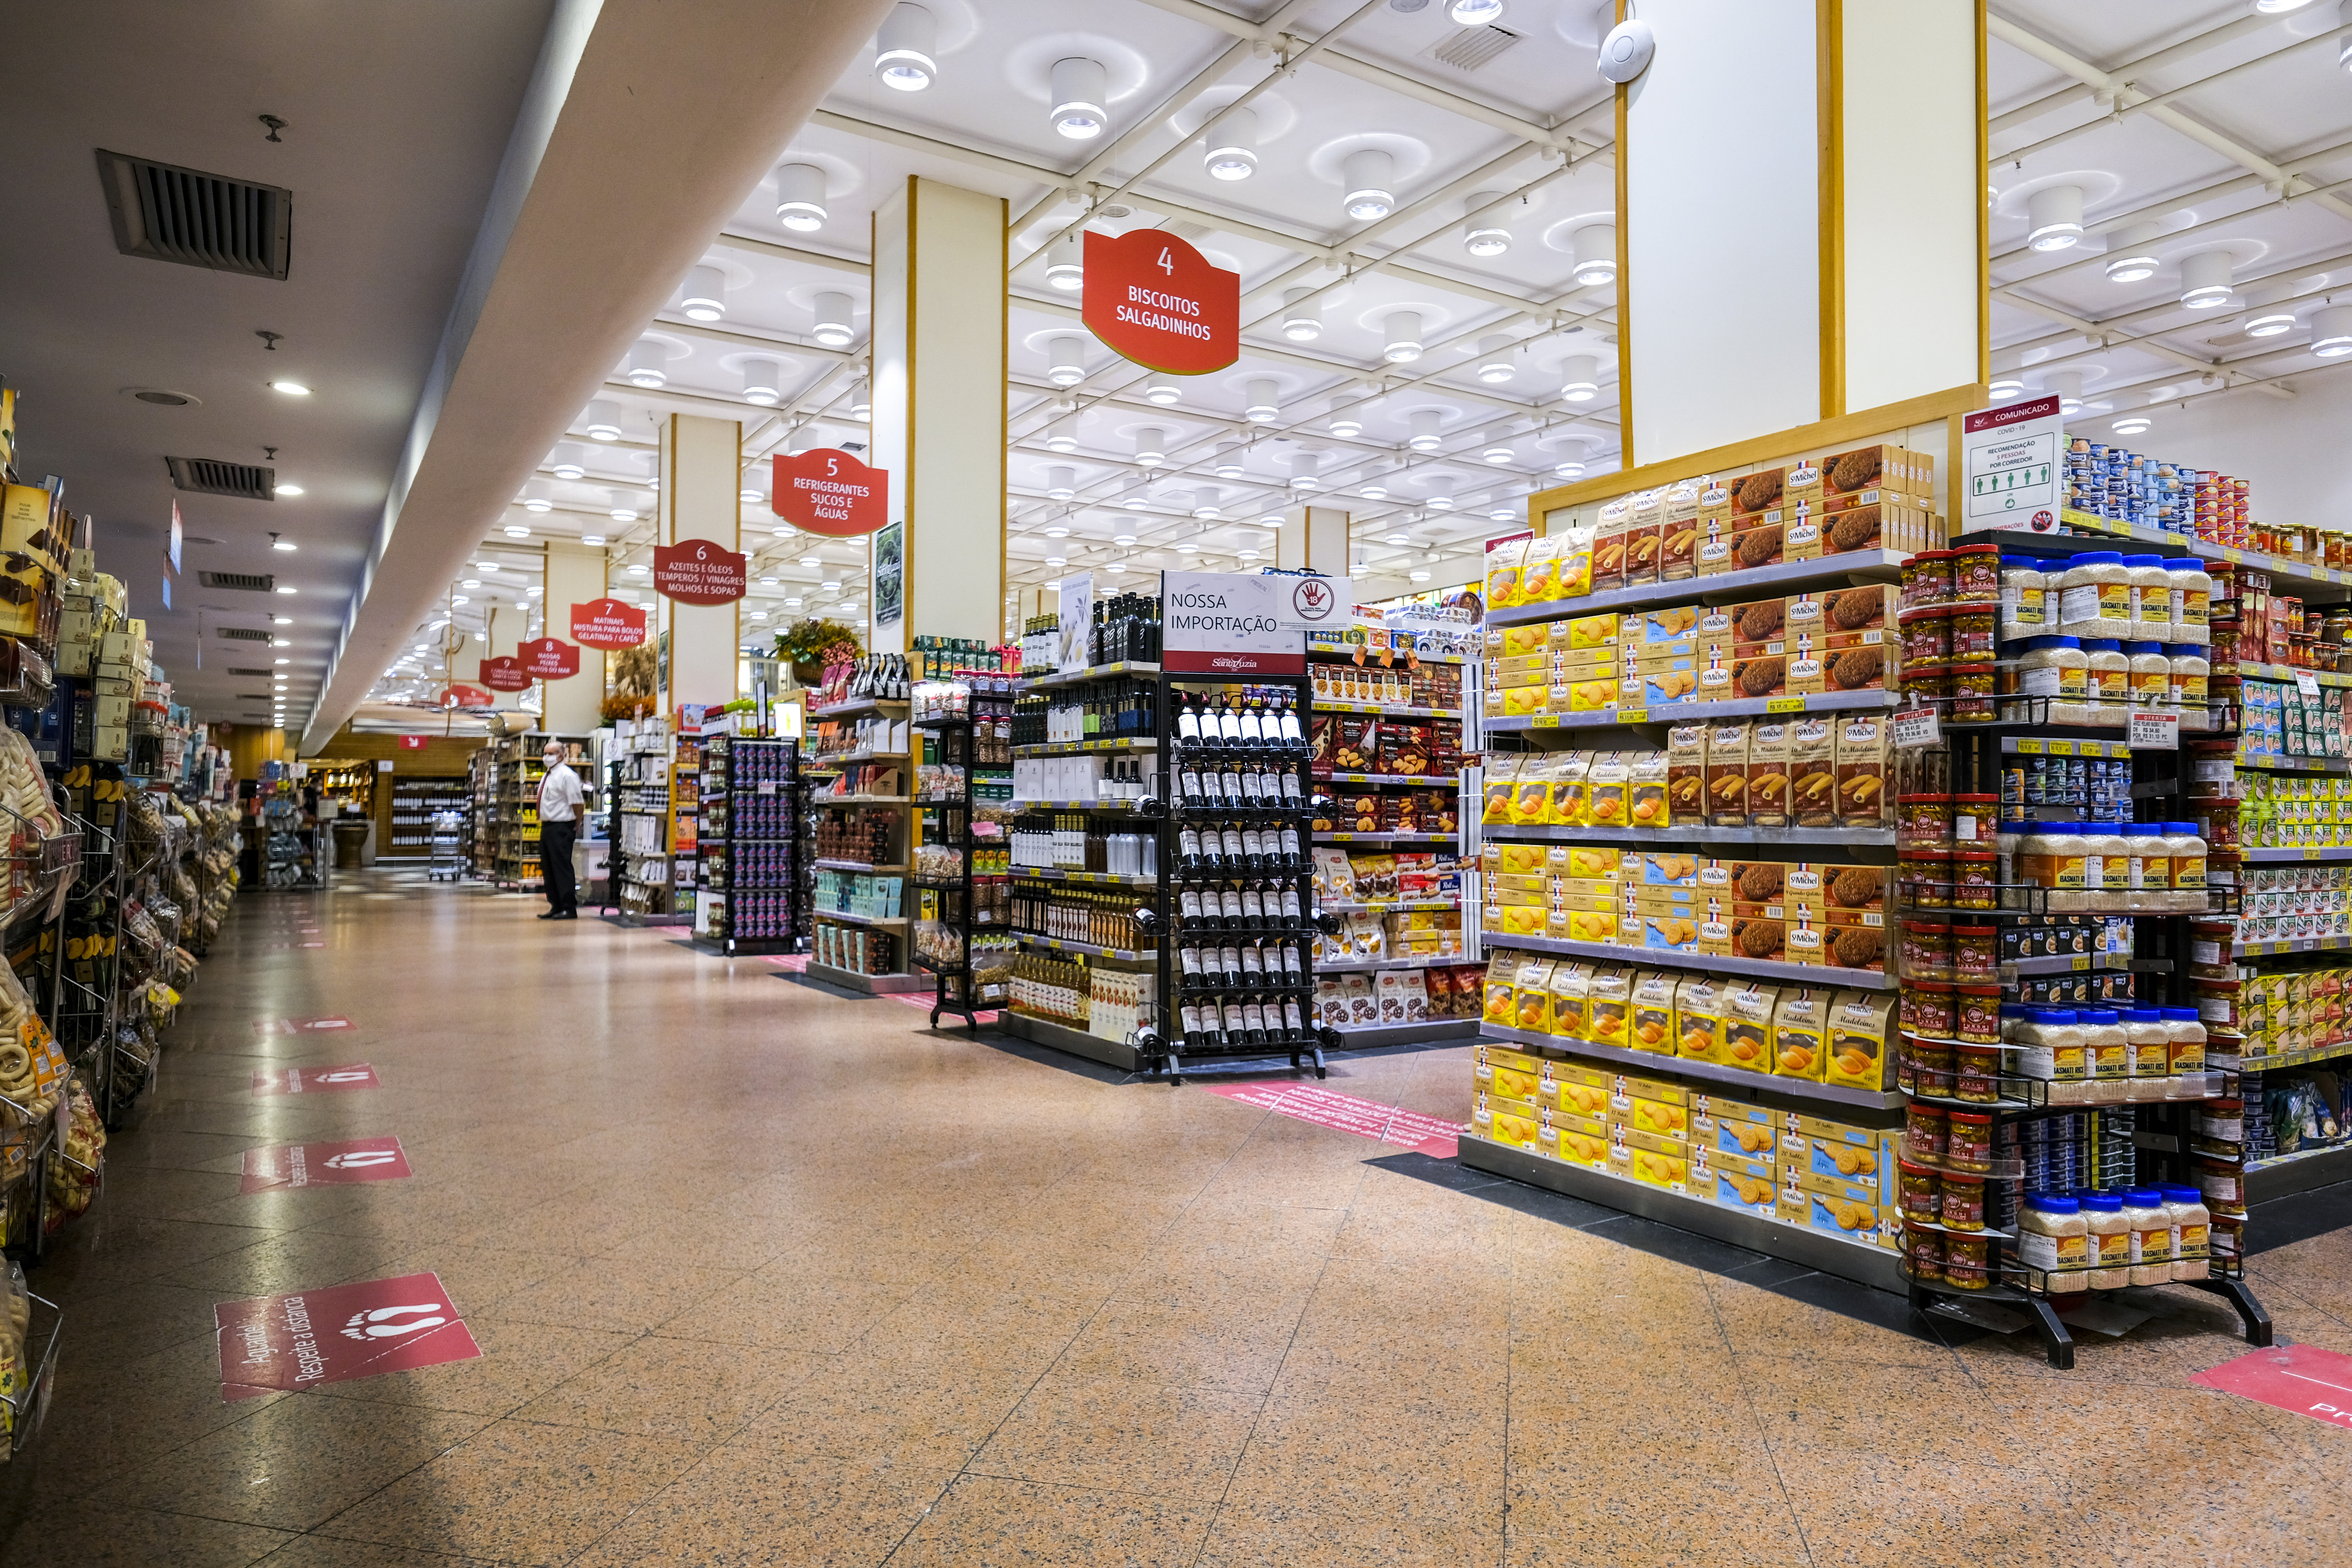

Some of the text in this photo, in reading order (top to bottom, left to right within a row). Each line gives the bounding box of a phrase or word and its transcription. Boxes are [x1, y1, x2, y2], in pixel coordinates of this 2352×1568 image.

[1157, 247, 1173, 276] 4
[1129, 285, 1200, 317] BISCOITOS
[1116, 305, 1211, 341] SALGADINHOS
[1995, 404, 2049, 421] COMUNICADO
[1988, 441, 2035, 454] RECOMENDAÇÃO
[2001, 450, 2026, 459] PESSOAS
[2002, 456, 2032, 466] CORREDOR
[827, 458, 838, 476] 5
[794, 478, 869, 497] REFRIGERANTES
[811, 493, 853, 508] SUCOS E
[814, 505, 848, 520] ÁGUAS
[697, 545, 706, 560] 6
[668, 562, 700, 572] AZEITES
[708, 562, 733, 574] ÓLEOS
[657, 571, 745, 585] TEMPEROS / VINAGRES
[668, 583, 737, 596] MOLHOS E SOPAS
[1172, 593, 1227, 608] NOSSA
[605, 603, 613, 615] 7
[593, 616, 624, 626] MATINAIS
[1172, 615, 1277, 635] IMPORTAÇÃO
[573, 623, 643, 635] MISTURA PARA BOLOS
[578, 632, 613, 642] GELATINAS
[619, 633, 639, 643] CAFÉS
[546, 641, 553, 652] 8
[504, 659, 510, 668] 9
[1637, 993, 1665, 1002] Madeleines
[1684, 998, 1714, 1009] Madeleines
[1729, 1005, 1762, 1017] Madeleines
[1781, 1014, 1815, 1024] Madeleines
[1838, 1015, 1875, 1028] Madeleines
[279, 1296, 311, 1332] distância
[288, 1340, 329, 1382] Respeite
[2309, 1403, 2352, 1425] Pr
